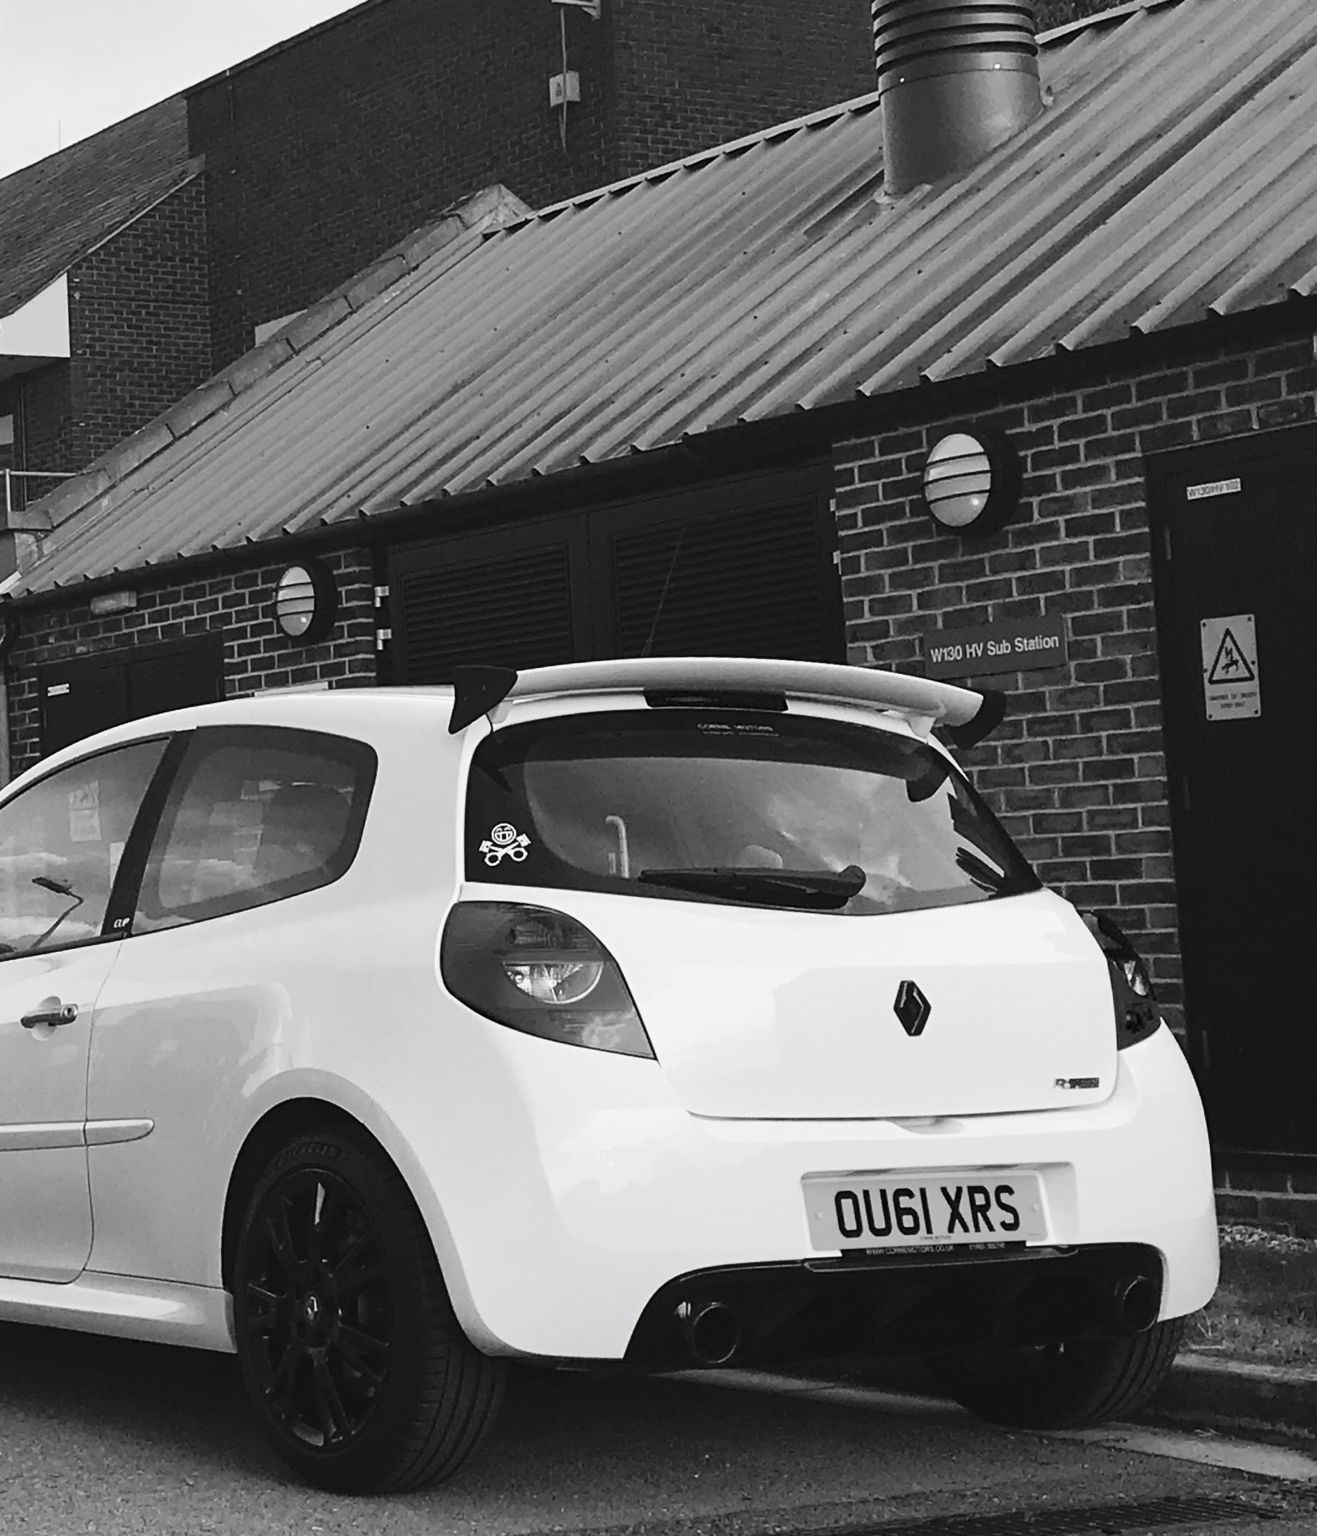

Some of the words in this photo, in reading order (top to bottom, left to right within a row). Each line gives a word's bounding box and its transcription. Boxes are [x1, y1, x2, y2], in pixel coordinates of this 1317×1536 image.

[930, 645, 963, 663] W130
[965, 642, 983, 658] HV
[987, 640, 1011, 656] Sub
[1014, 635, 1059, 653] Station
[834, 1187, 934, 1238] OU61
[940, 1184, 1021, 1234] XRS
